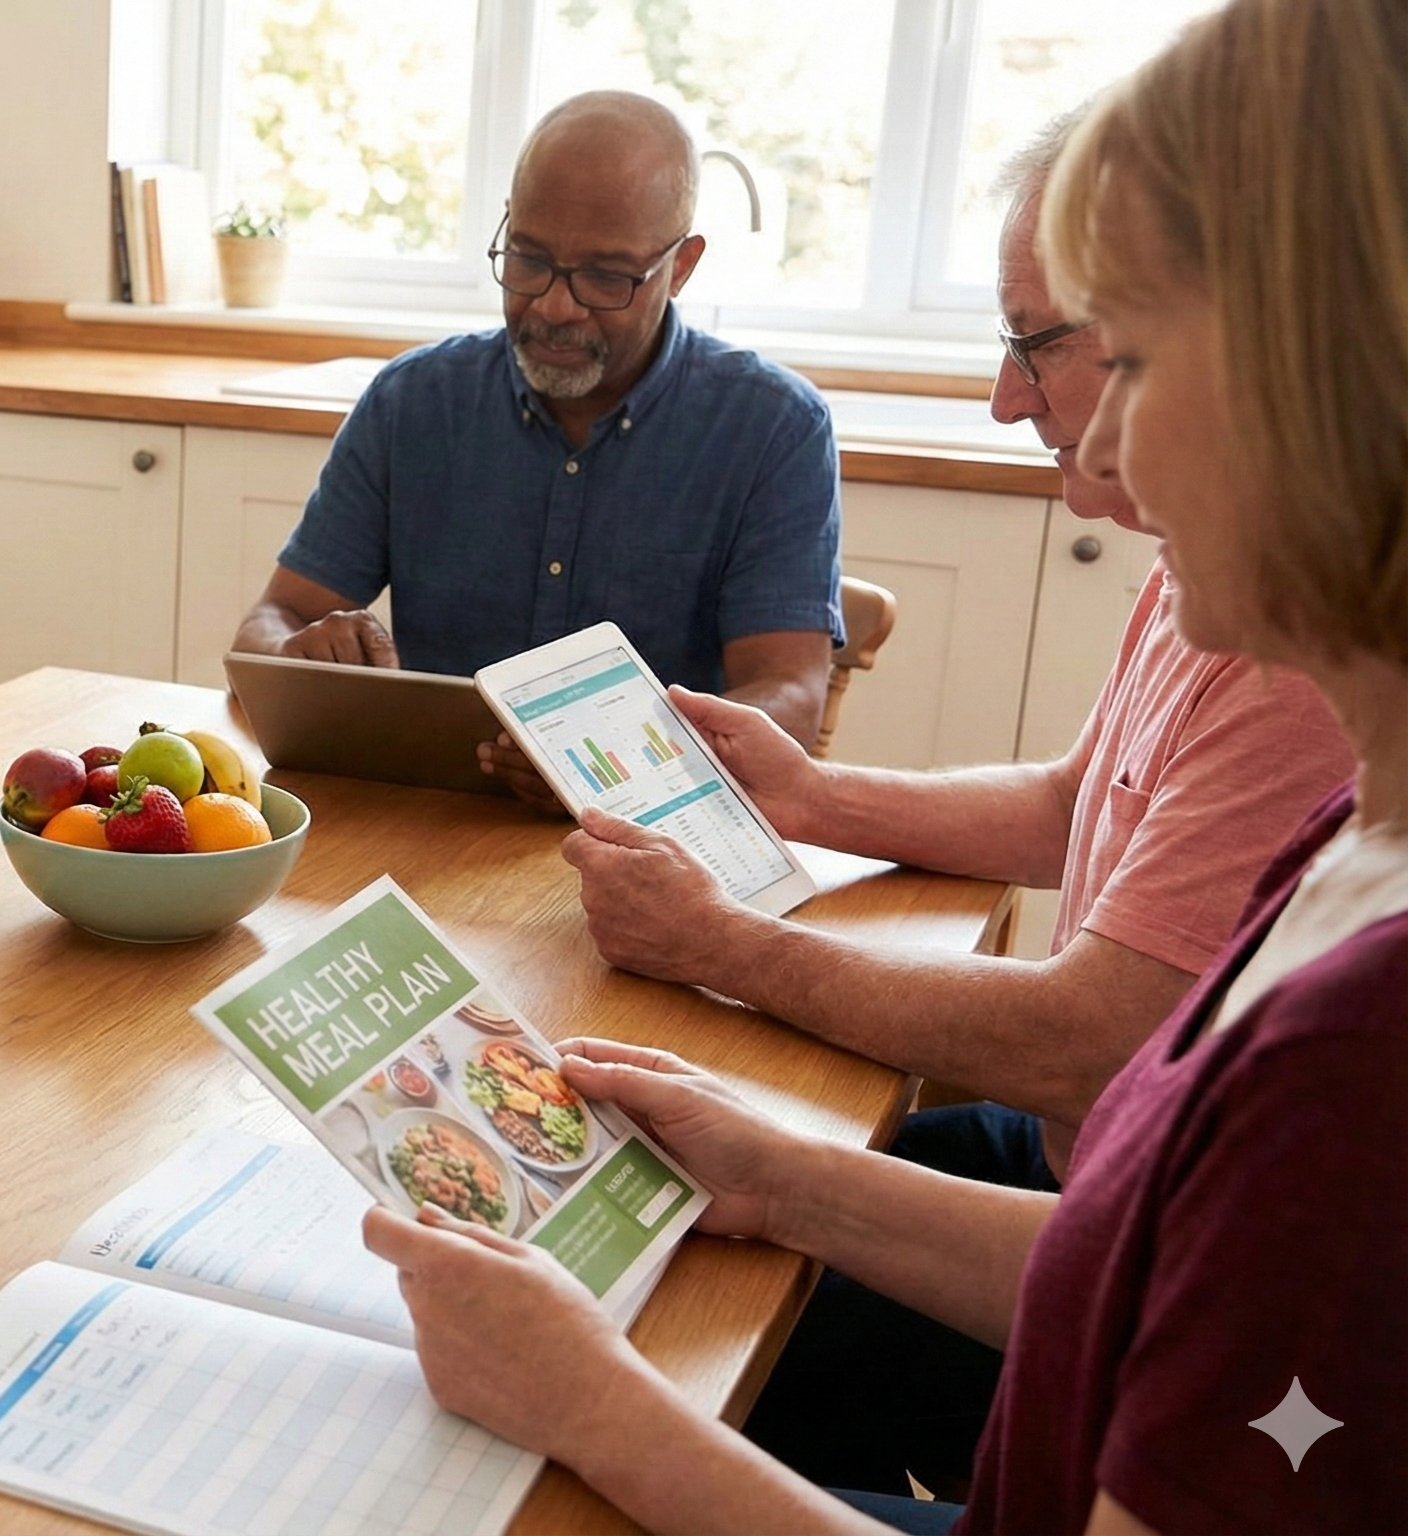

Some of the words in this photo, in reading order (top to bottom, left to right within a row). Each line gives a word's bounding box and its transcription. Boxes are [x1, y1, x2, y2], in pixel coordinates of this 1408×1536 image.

[245, 940, 384, 1051] HEALTHY
[281, 1013, 380, 1089] MEAL
[361, 953, 452, 1029] PLAN
